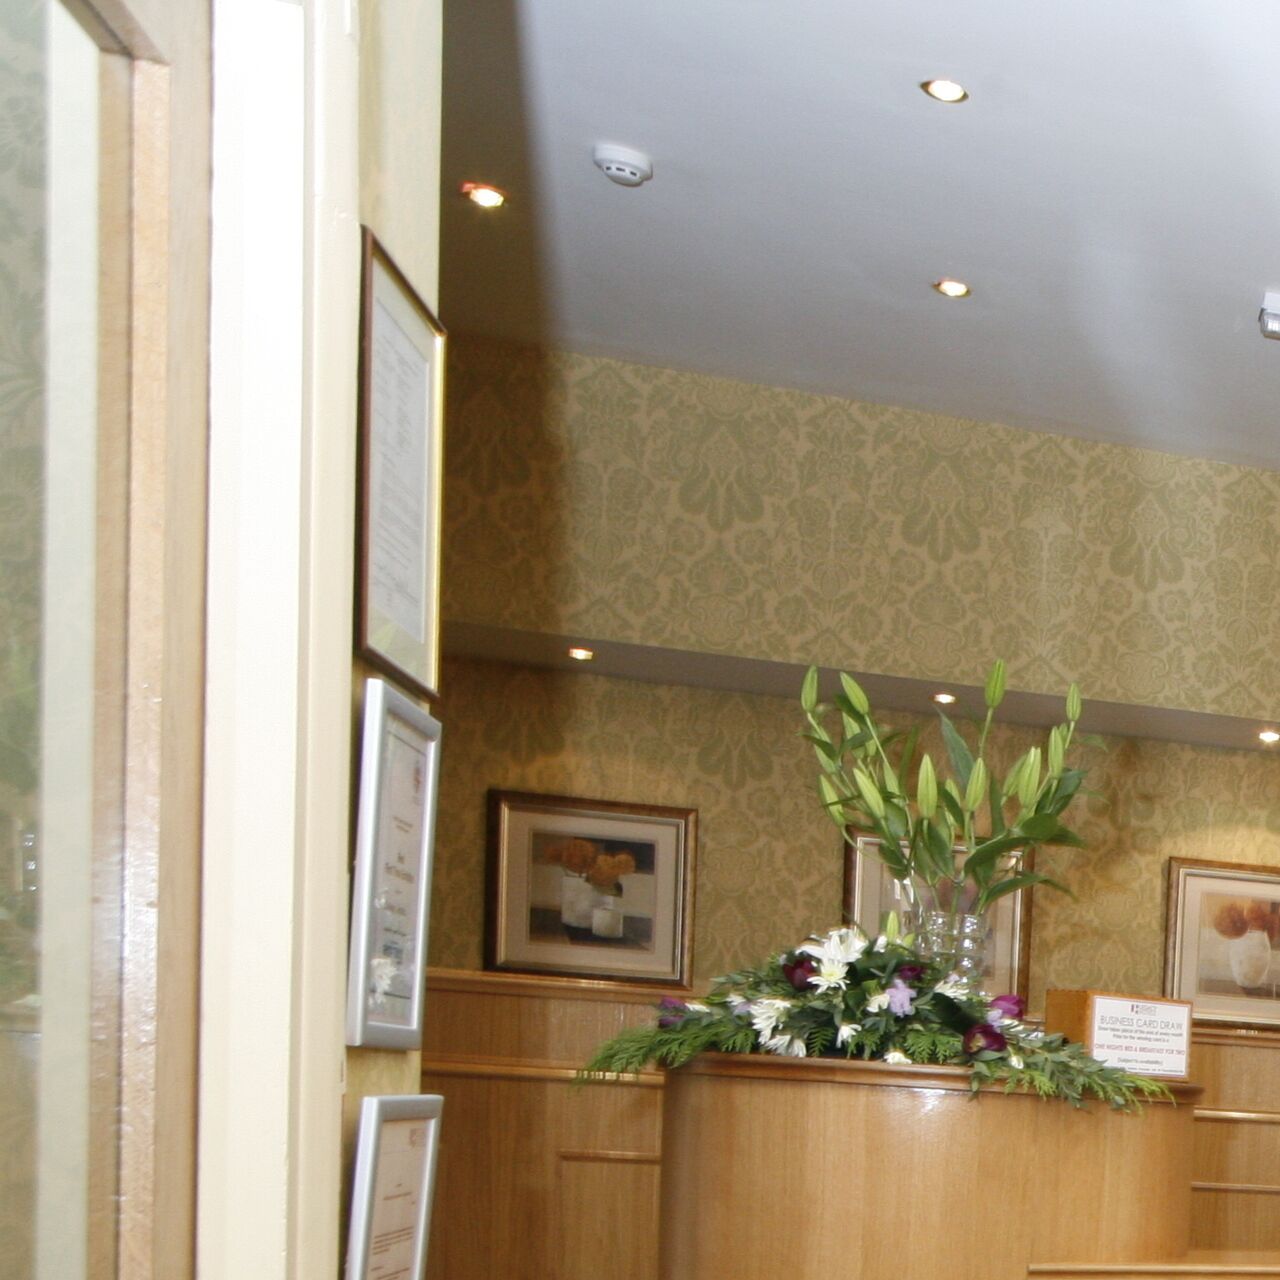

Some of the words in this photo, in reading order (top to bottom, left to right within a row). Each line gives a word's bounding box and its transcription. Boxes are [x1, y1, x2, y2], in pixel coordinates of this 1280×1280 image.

[1100, 1015, 1134, 1027] BUSINESS
[1136, 1019, 1159, 1028] CARD
[1160, 1020, 1184, 1030] DRAW
